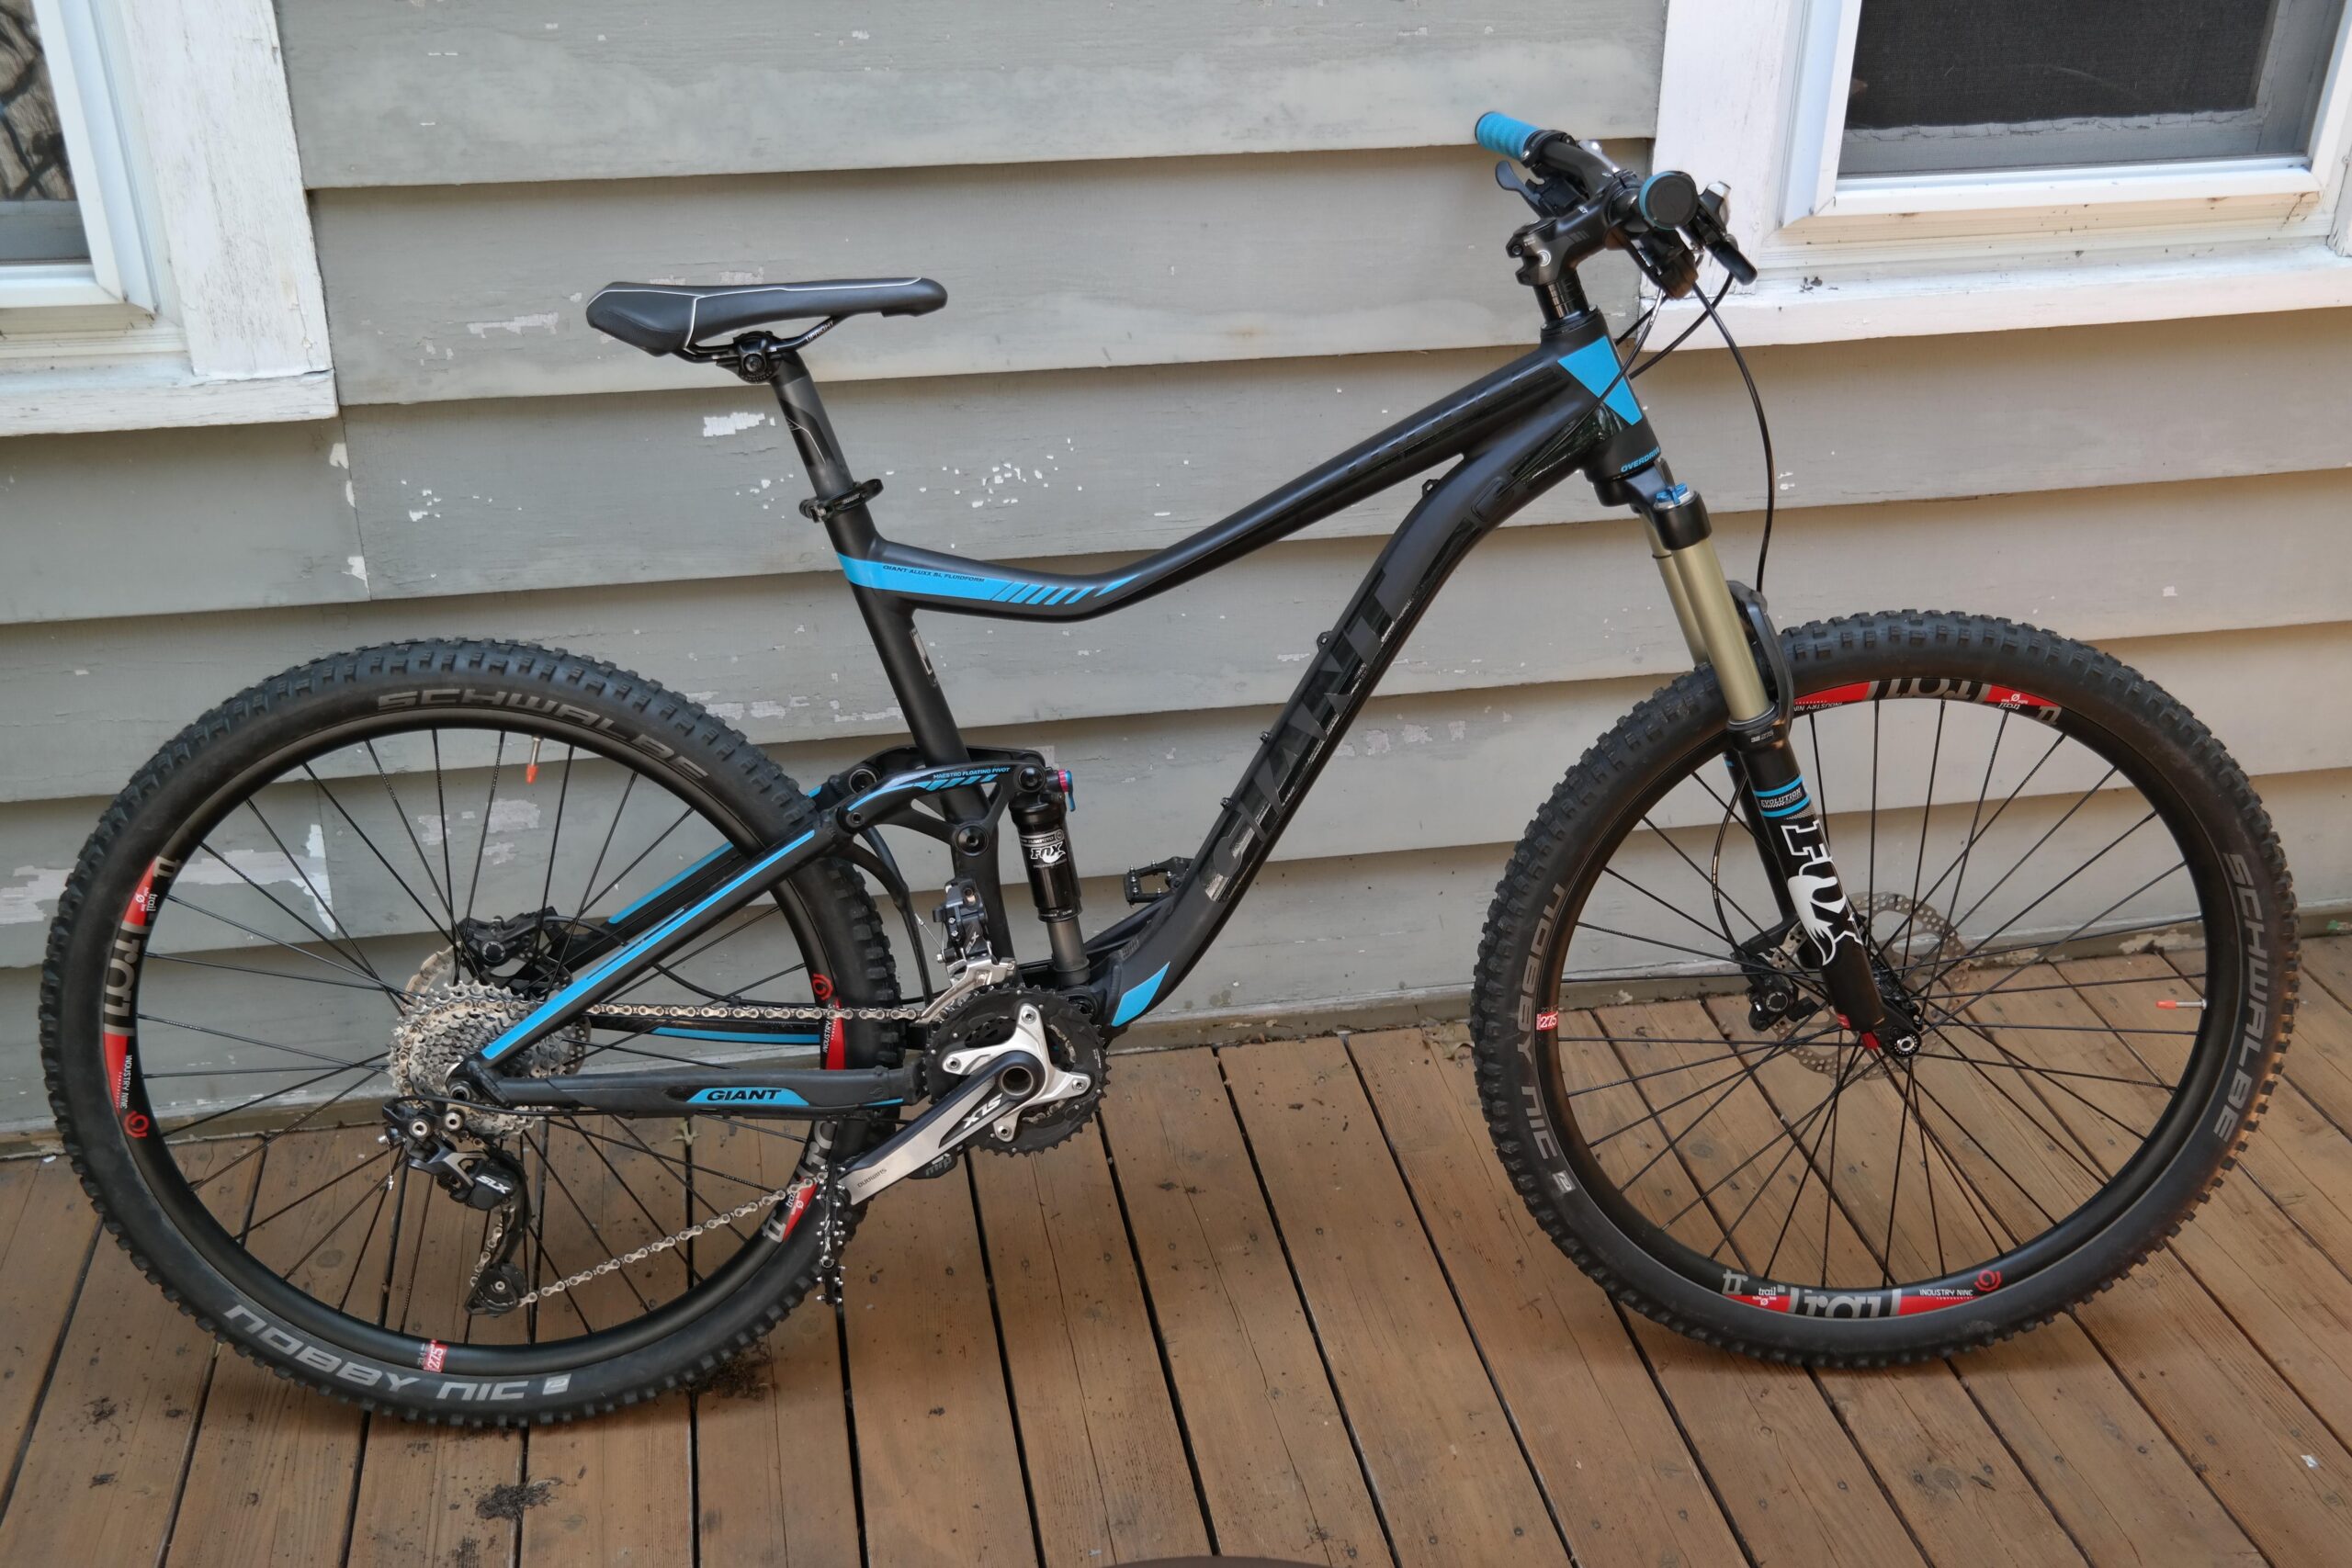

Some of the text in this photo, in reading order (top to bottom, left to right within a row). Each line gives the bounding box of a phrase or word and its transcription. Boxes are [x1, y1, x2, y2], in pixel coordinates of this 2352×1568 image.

[944, 574, 985, 582] FLUIDFORM
[1806, 701, 1843, 711] INDUSTRY
[1997, 702, 2020, 710] trail
[378, 689, 708, 780] SCHWALBE
[1198, 570, 1395, 903] GIANT
[1760, 787, 1802, 807] EVOLUTION
[1031, 841, 1066, 863] FOX
[147, 893, 158, 912] trail
[1781, 819, 1863, 965] FOX
[2213, 852, 2268, 1144] SCHWALBE
[1517, 883, 1566, 1159] NOBBY NIC
[822, 1021, 831, 1053] INDUSTRY
[122, 1055, 132, 1090] INDUSTRY
[707, 1089, 782, 1101] GIANT
[963, 1093, 1002, 1129] SLX
[476, 1175, 511, 1194] SLX
[1758, 1286, 1776, 1296] trail
[1919, 1288, 1955, 1296] INDUSTRY
[224, 1304, 529, 1401] NOBBY NIC
